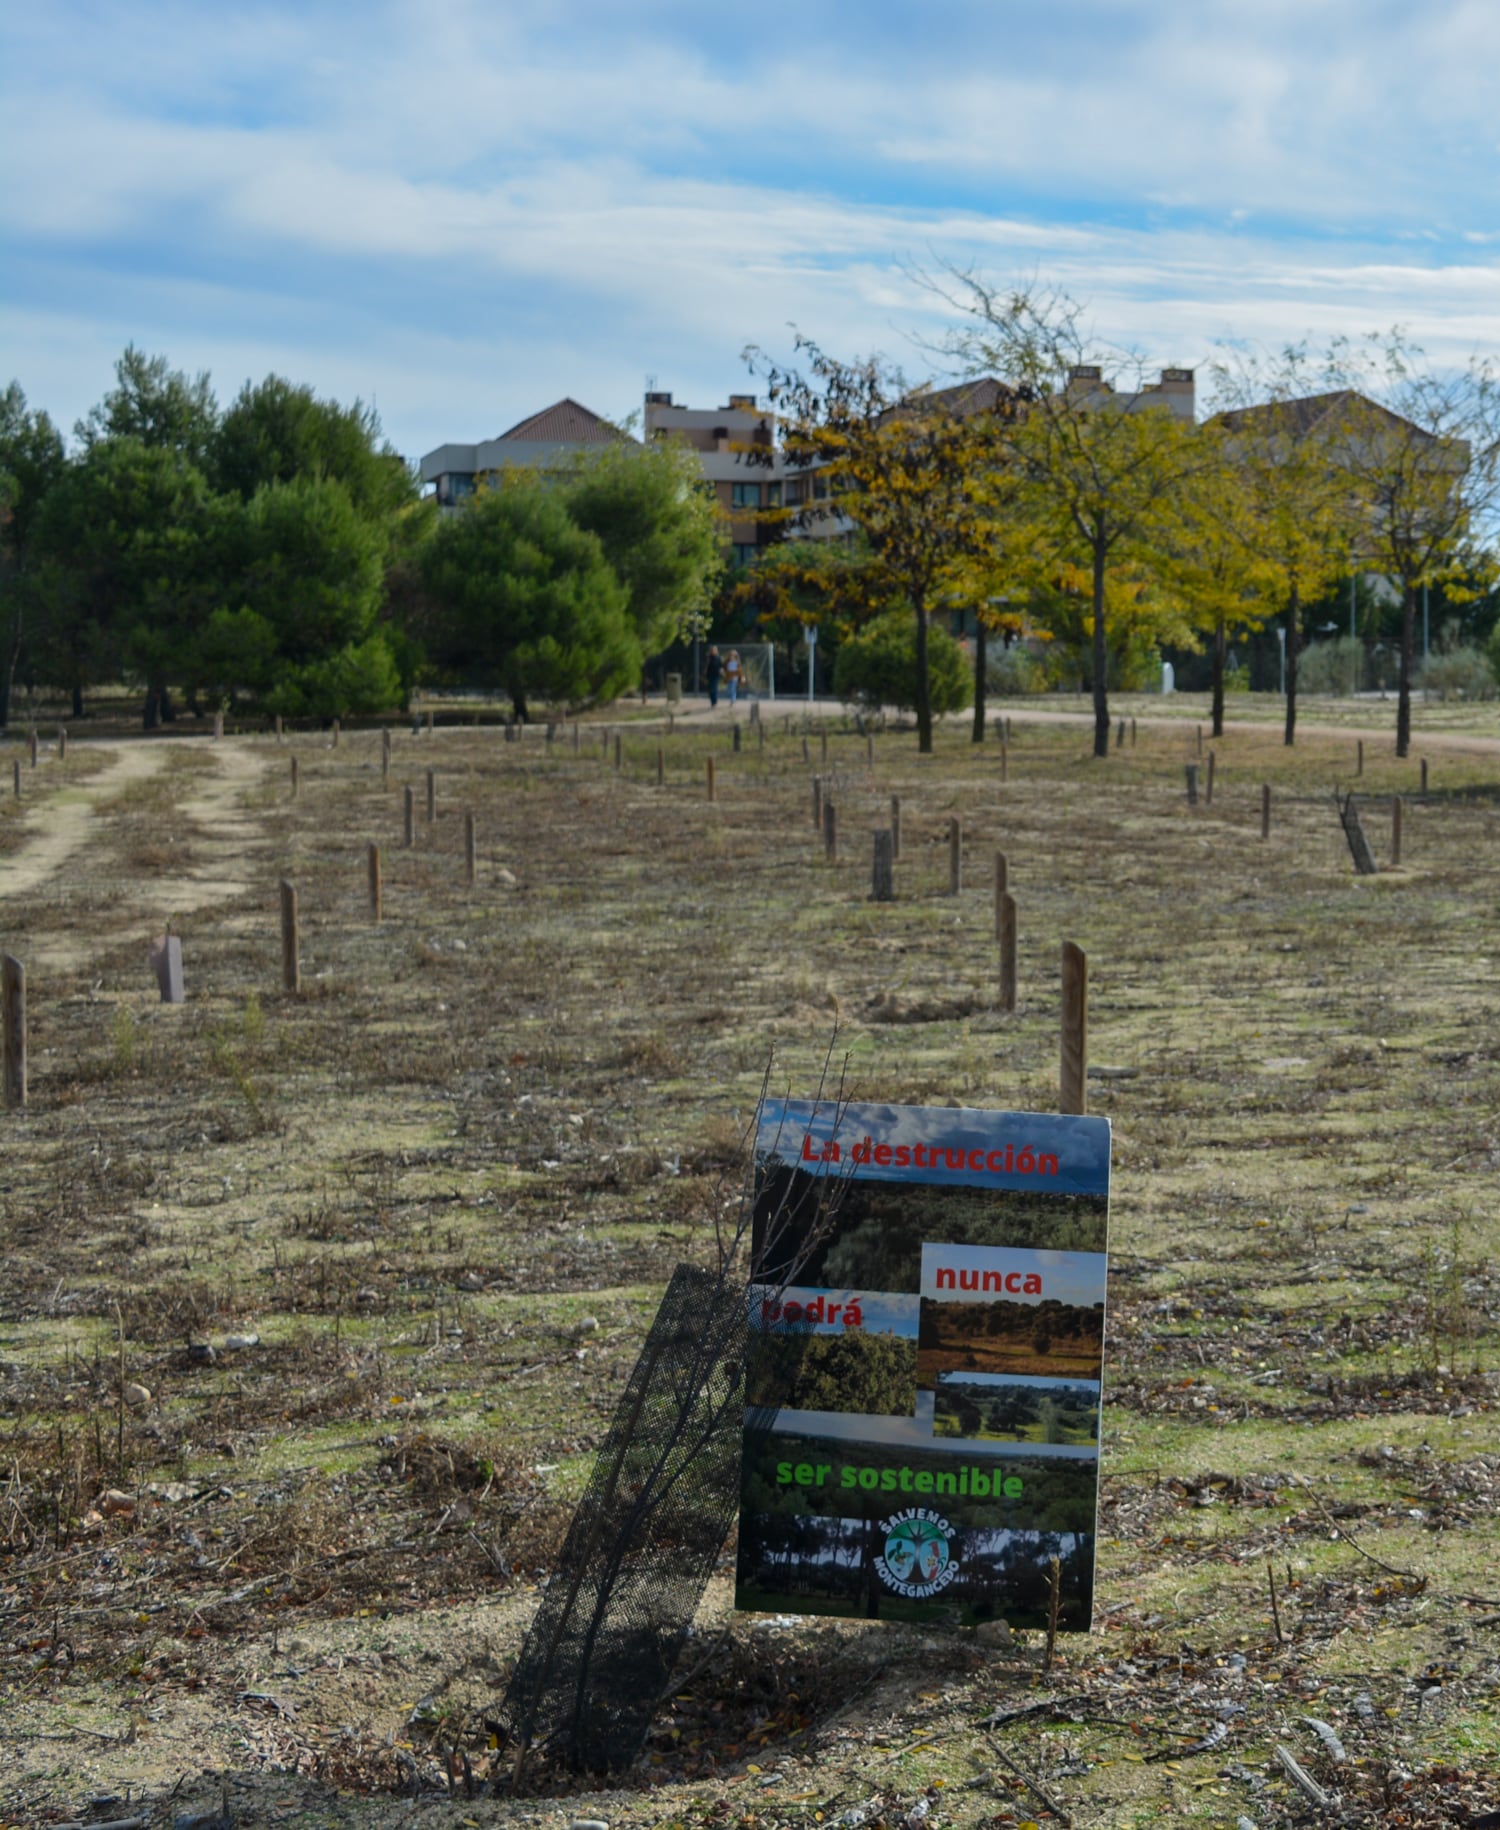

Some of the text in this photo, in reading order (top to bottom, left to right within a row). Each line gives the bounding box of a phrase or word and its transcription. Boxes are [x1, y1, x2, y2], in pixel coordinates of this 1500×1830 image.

[802, 1134, 1059, 1175] La destrucción
[935, 1267, 1042, 1295] nunca
[776, 1461, 1024, 1499] ser sostenible
[880, 1508, 957, 1539] SALVEMOS
[873, 1556, 960, 1597] MONTEGANCEDO
